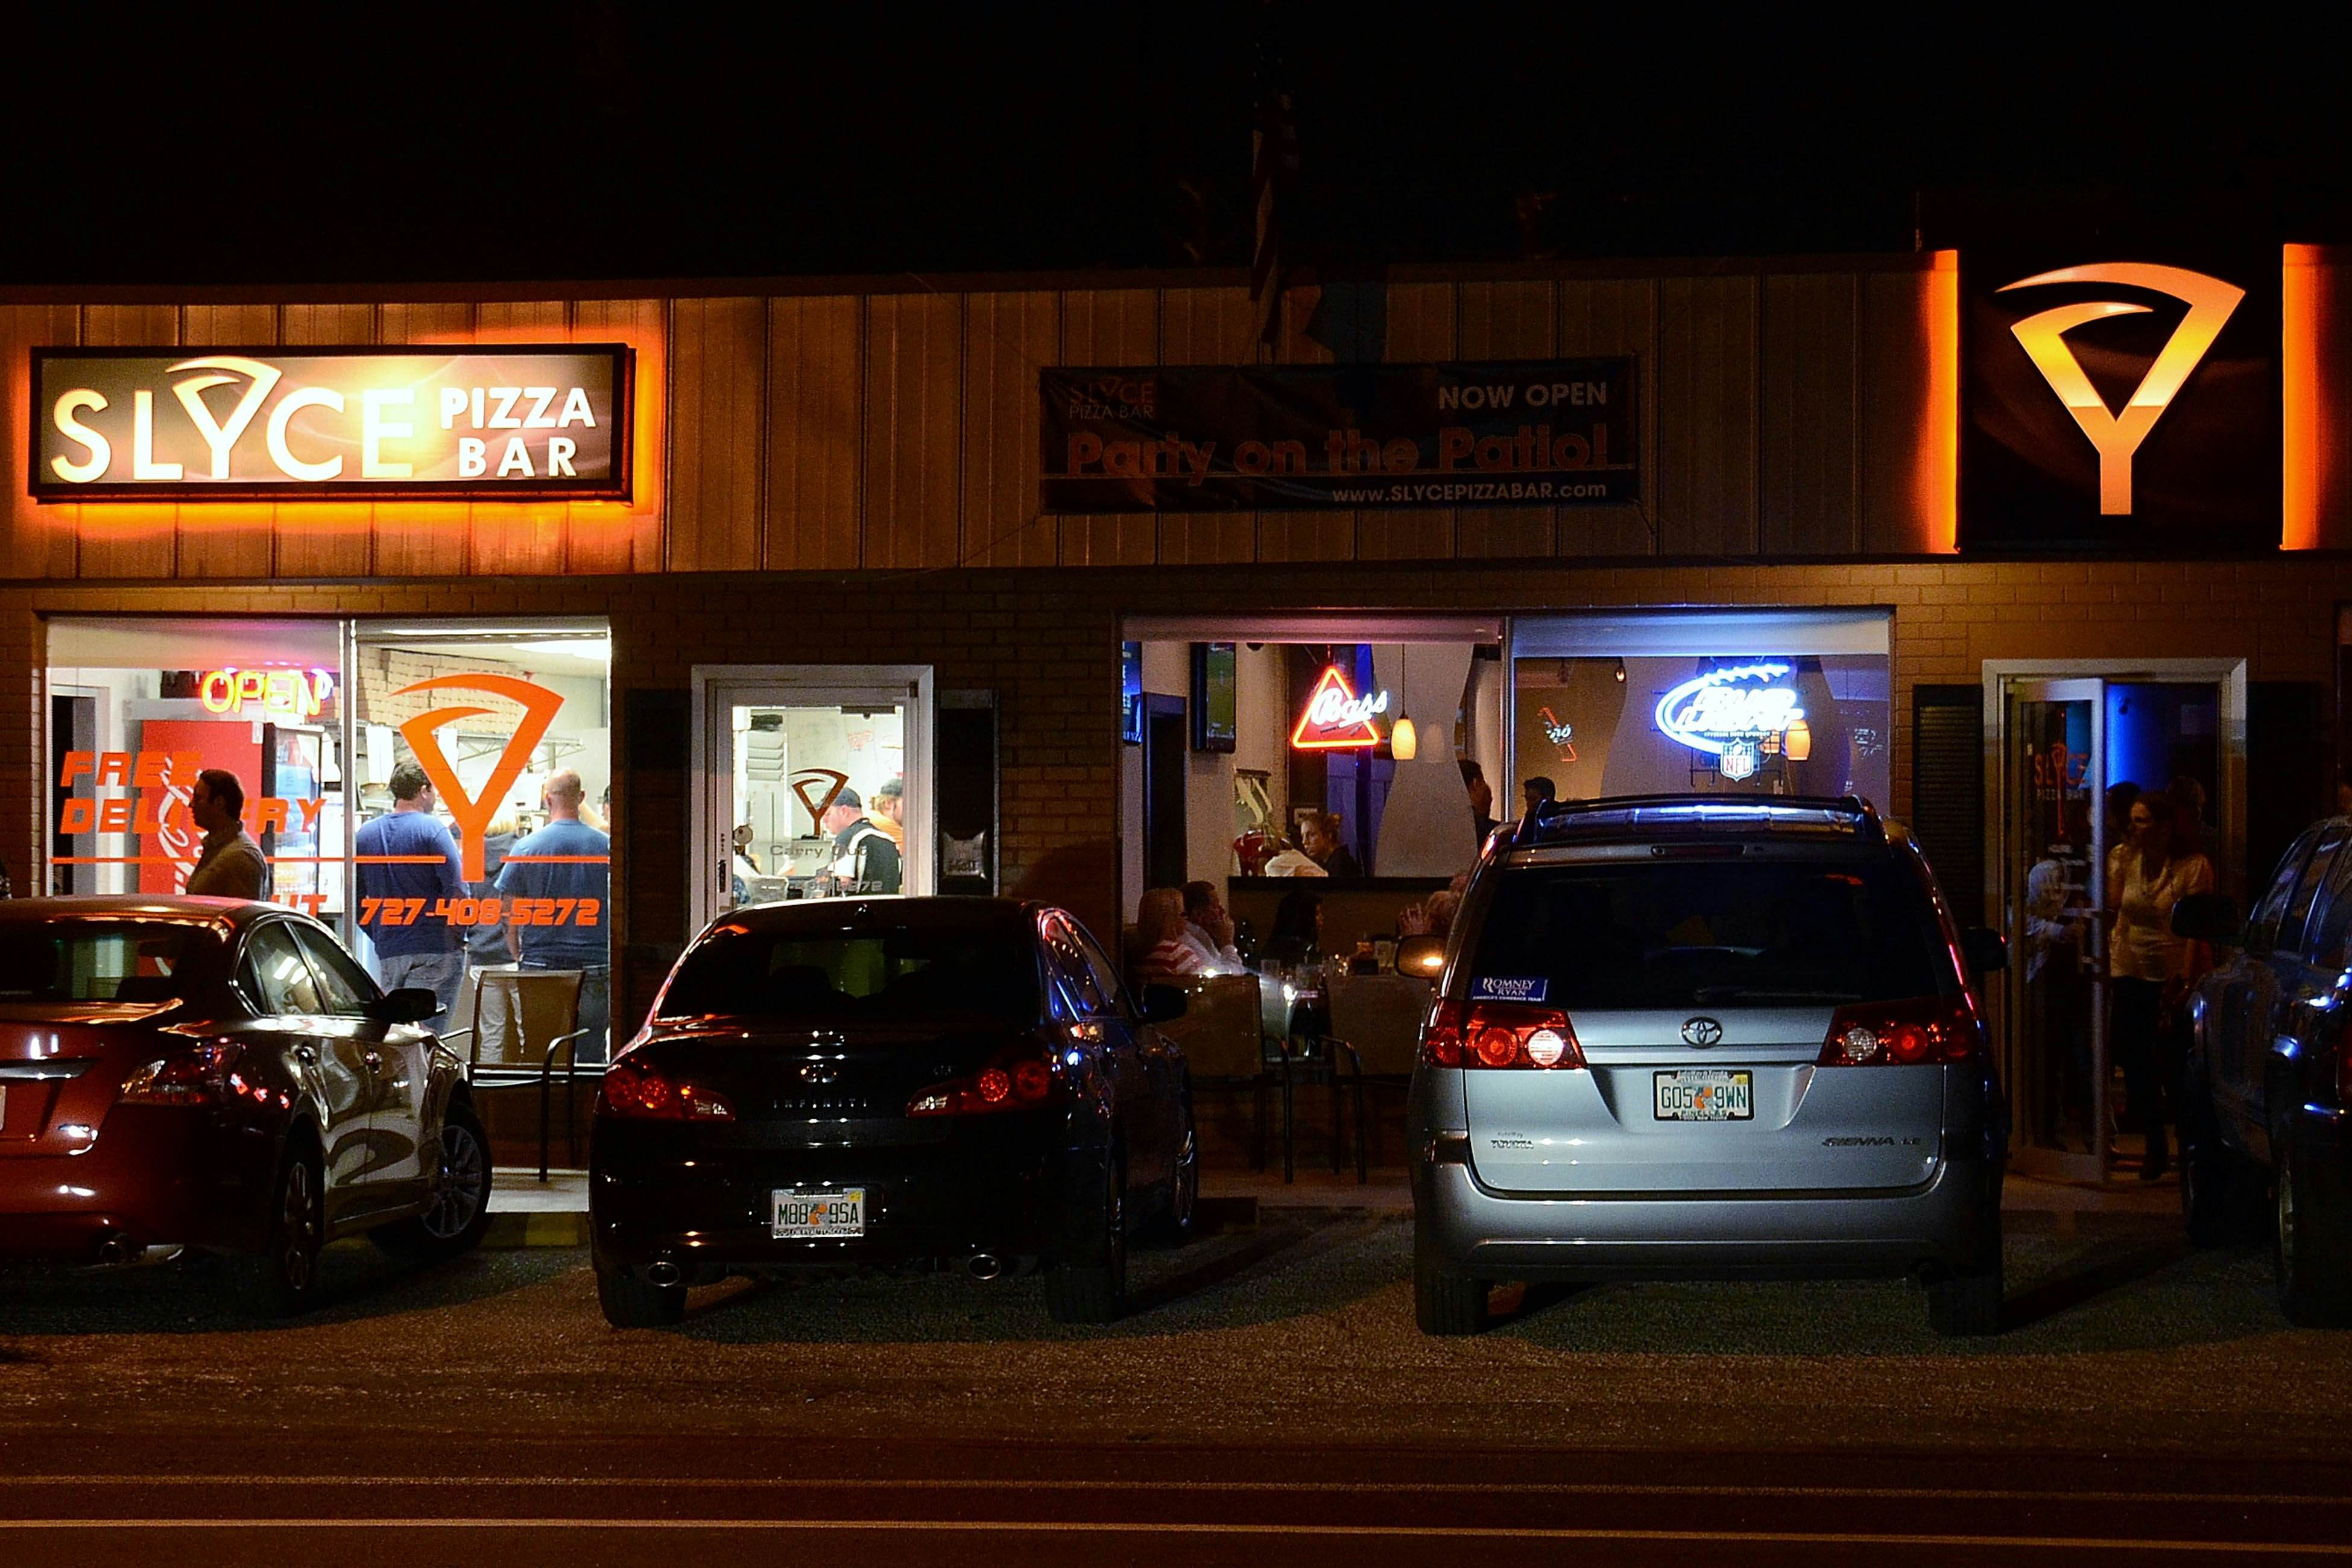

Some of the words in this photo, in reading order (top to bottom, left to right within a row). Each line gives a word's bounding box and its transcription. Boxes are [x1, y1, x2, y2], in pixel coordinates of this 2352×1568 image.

[1069, 377, 1156, 405] SLYCE
[1438, 385, 1515, 409] NOW
[1525, 381, 1607, 406] OPEN
[51, 356, 414, 482] SLYCE
[439, 387, 596, 429] PIZZA
[1069, 405, 1114, 420] PIZZA
[1119, 404, 1154, 420] BAR
[458, 437, 577, 478] BAR
[1067, 431, 1216, 487] Party
[1234, 439, 1306, 474] on
[1325, 429, 1419, 474] the
[1439, 422, 1607, 473] Patio!
[1331, 482, 1608, 502] www.SLYCEPIZZABAR.com
[201, 670, 321, 716] OPEN
[1310, 687, 1388, 728] Bass
[61, 751, 202, 786] FREE
[1725, 757, 1750, 774] NFL
[770, 845, 823, 858] Carry
[358, 898, 601, 926] 727-408-5272
